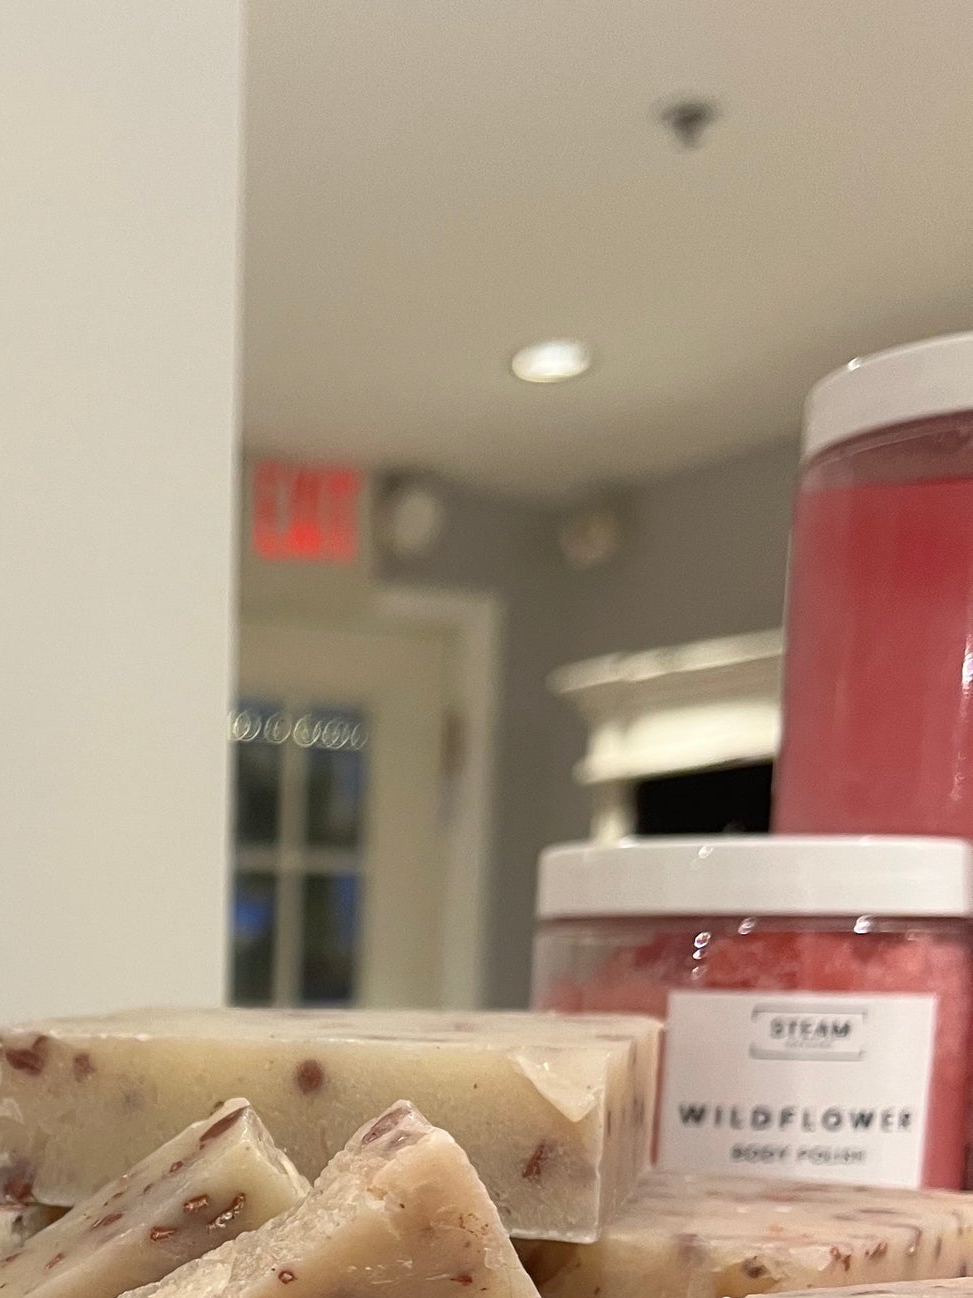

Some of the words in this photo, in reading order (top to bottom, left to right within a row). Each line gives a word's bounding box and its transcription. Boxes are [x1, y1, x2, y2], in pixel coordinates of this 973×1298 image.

[770, 1017, 852, 1040] STEAM
[678, 1103, 913, 1133] WILDFLOWER
[730, 1142, 789, 1165] BODY
